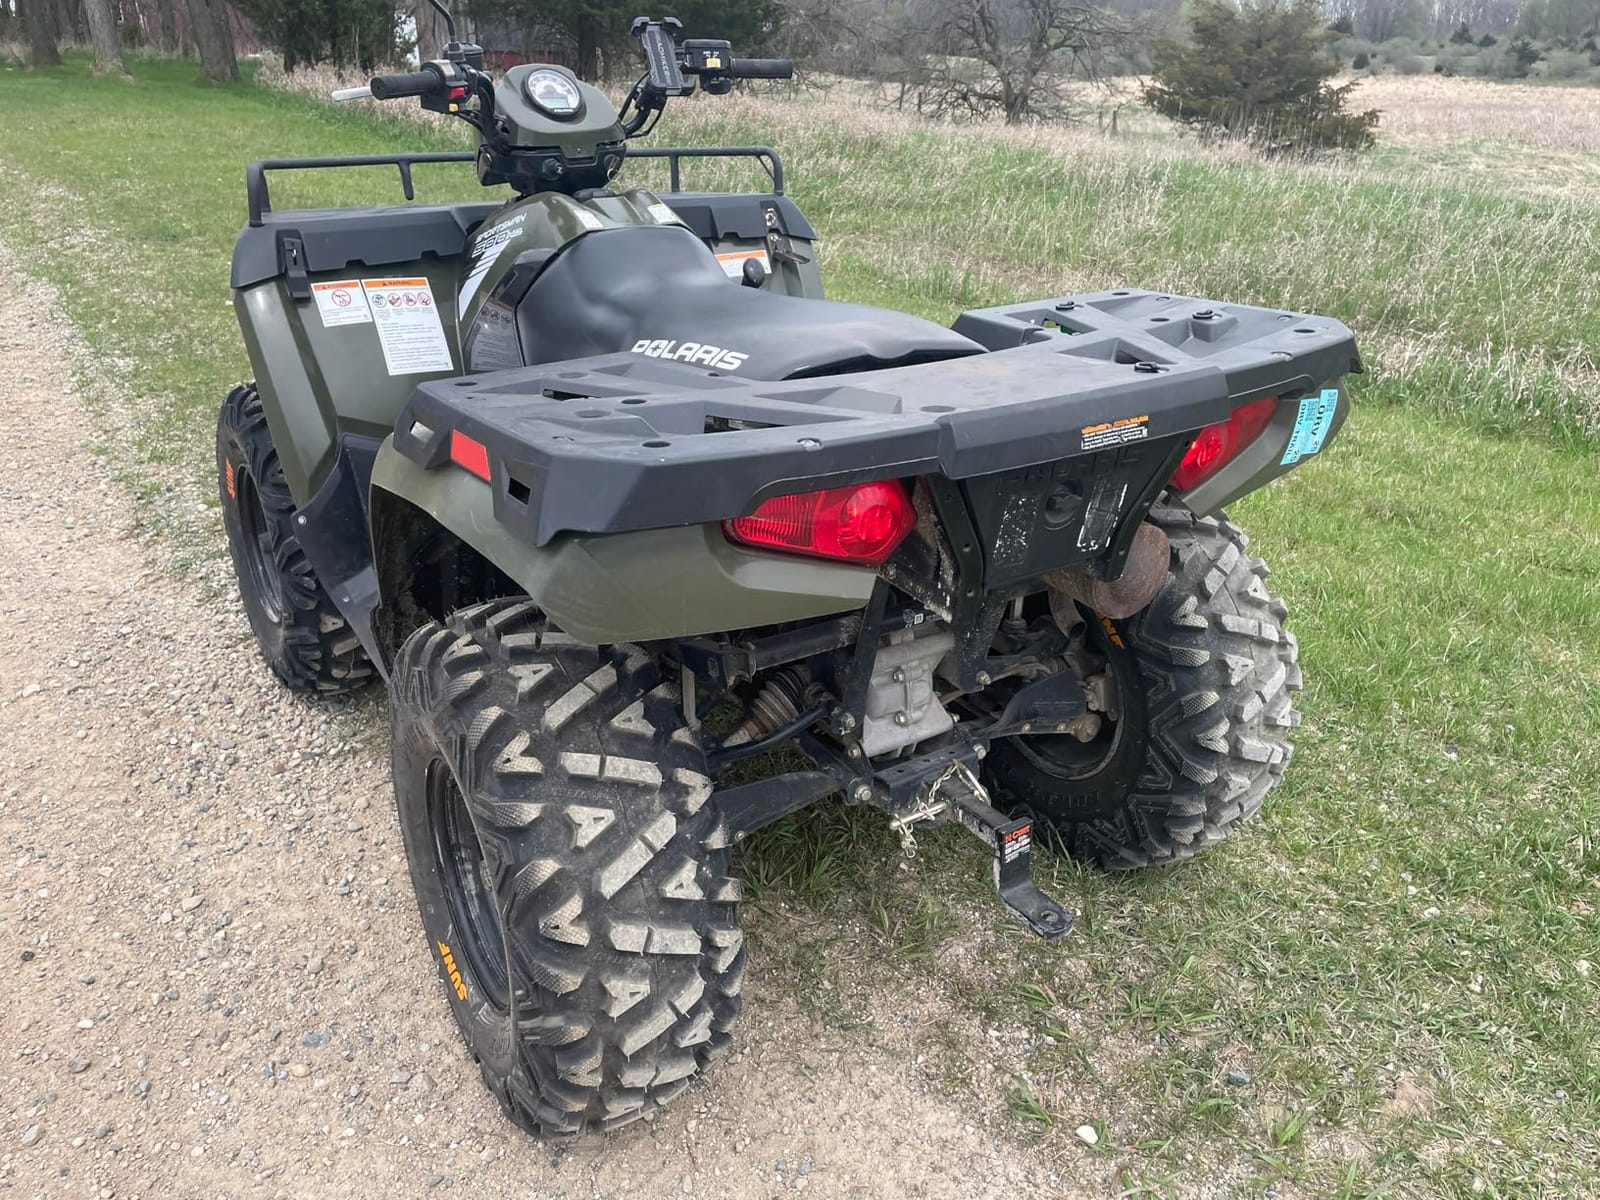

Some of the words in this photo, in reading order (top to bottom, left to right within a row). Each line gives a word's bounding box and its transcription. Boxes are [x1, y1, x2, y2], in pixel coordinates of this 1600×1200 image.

[631, 339, 750, 371] POLARIS
[1310, 404, 1327, 436] ORV
[437, 940, 468, 1001] SUNF
